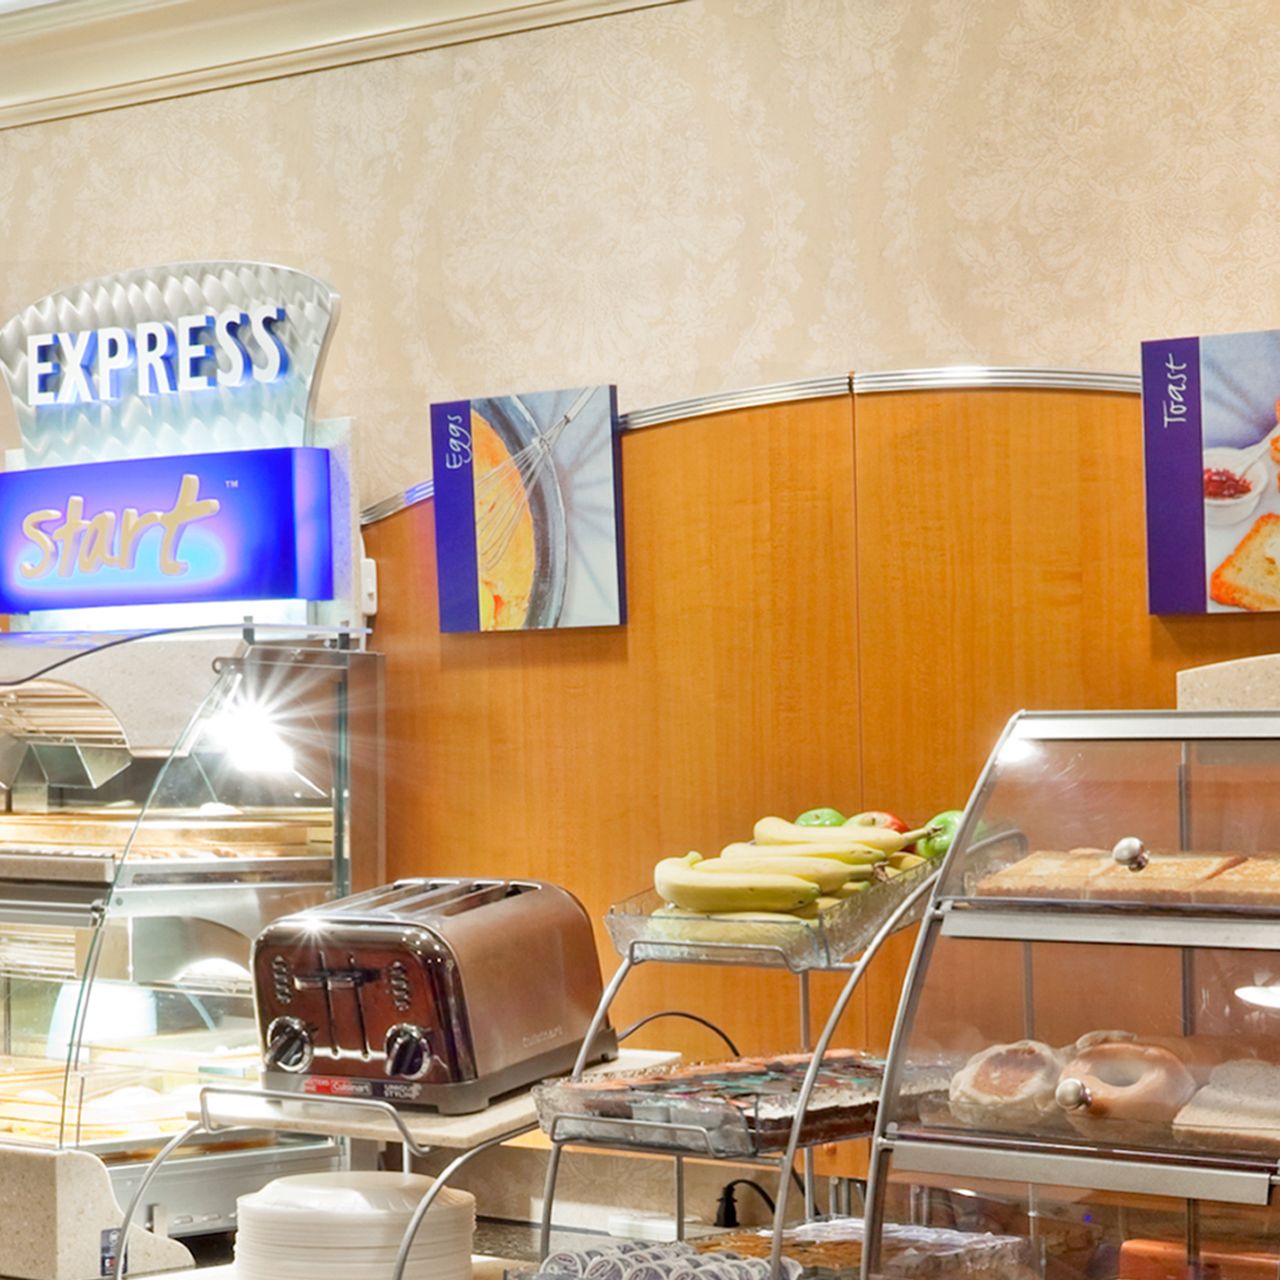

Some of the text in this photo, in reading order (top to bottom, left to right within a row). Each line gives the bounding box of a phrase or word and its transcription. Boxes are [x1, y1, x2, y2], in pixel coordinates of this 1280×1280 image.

[26, 305, 287, 407] EXPRESS
[1164, 352, 1187, 429] Toast
[446, 414, 472, 470] Eggs
[19, 473, 220, 578] start
